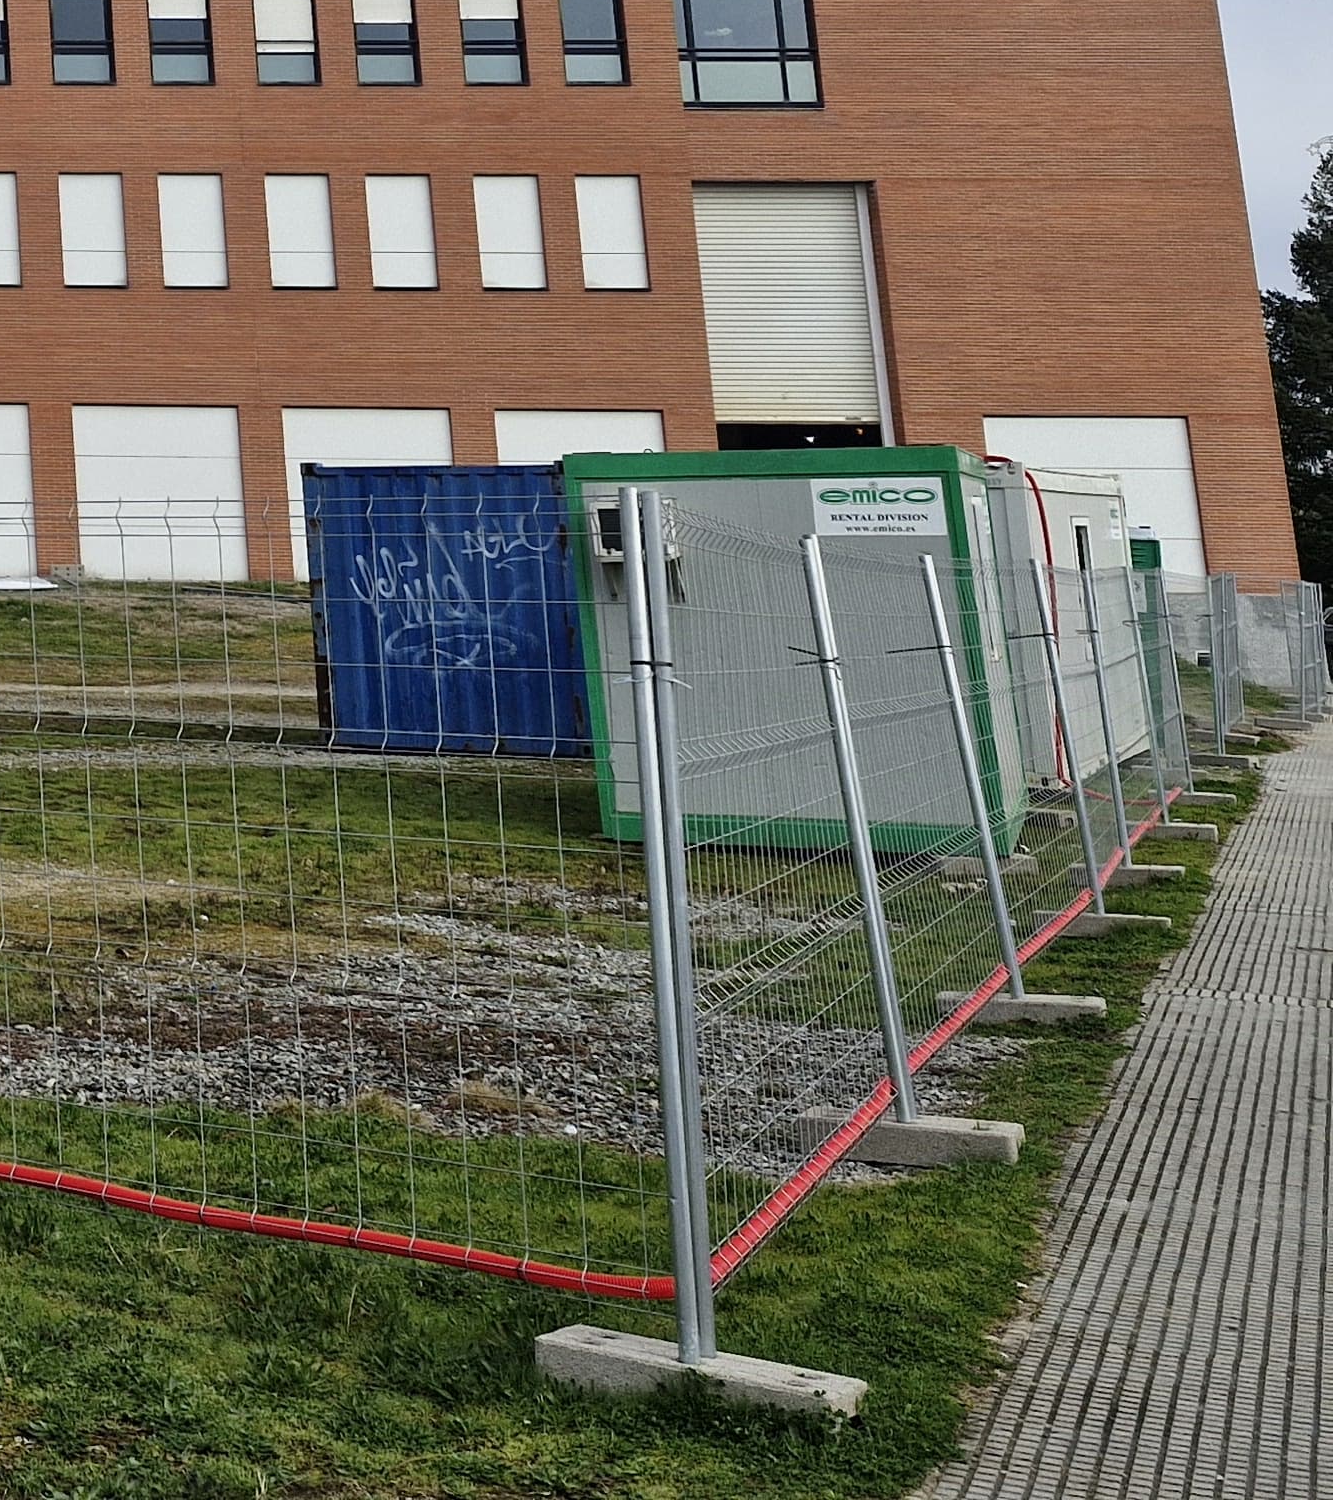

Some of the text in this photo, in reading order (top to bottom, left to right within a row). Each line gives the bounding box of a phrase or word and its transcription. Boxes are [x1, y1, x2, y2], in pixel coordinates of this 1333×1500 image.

[817, 483, 938, 505] emico
[830, 513, 929, 521] RENTAL DIVISION
[844, 524, 916, 533] www.emico.es
